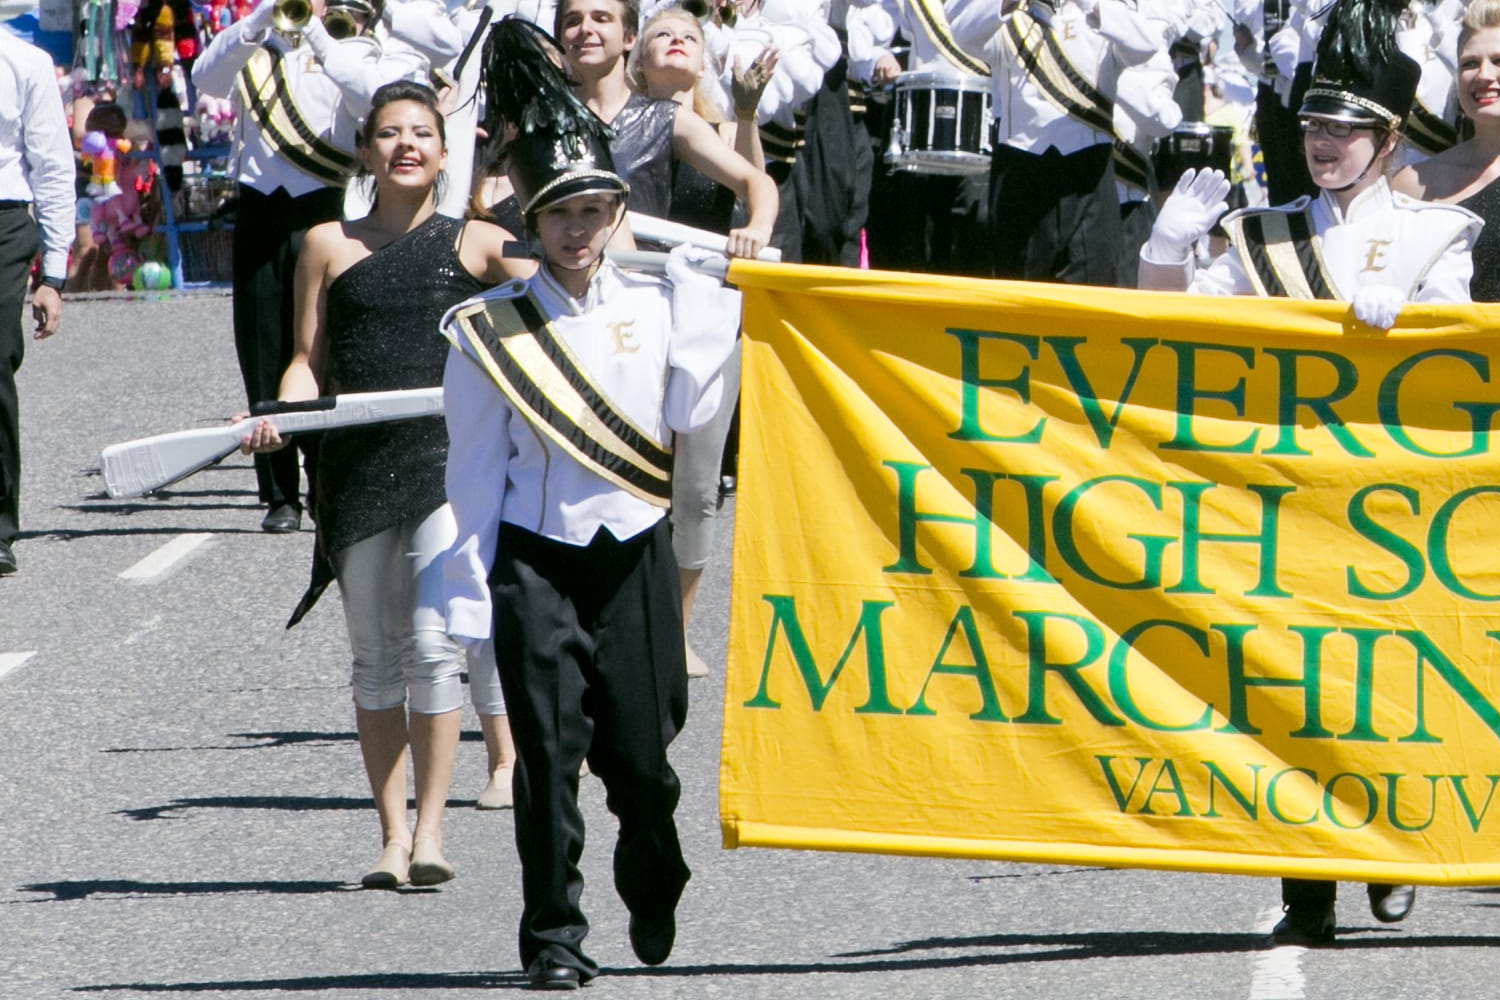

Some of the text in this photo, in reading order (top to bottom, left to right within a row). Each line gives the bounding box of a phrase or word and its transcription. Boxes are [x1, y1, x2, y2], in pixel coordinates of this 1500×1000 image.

[1063, 18, 1078, 41] E
[1359, 239, 1392, 273] E
[606, 320, 641, 356] E
[882, 460, 1297, 599] HIGH
